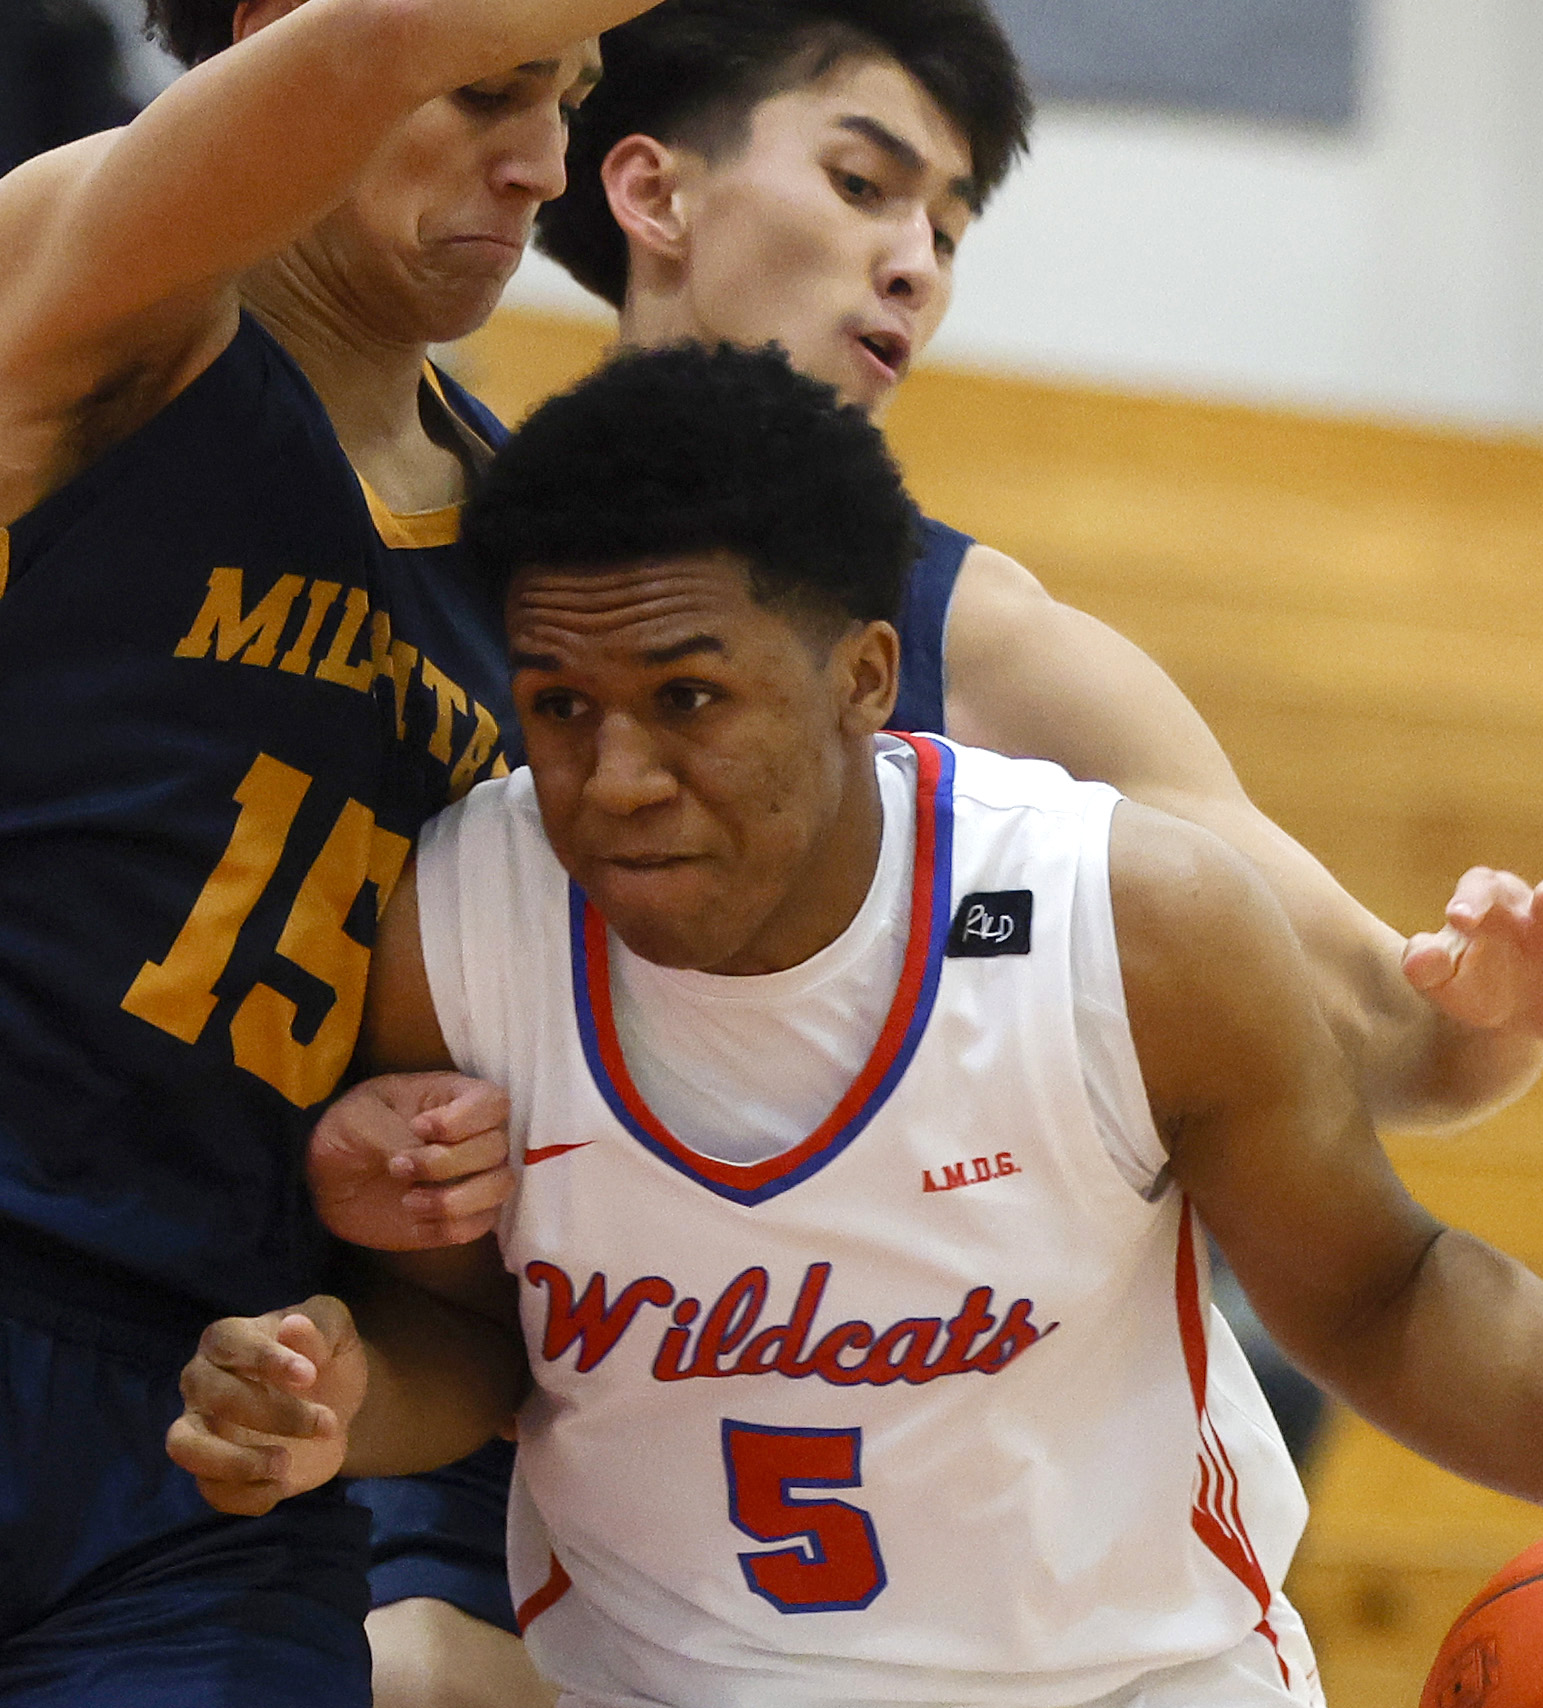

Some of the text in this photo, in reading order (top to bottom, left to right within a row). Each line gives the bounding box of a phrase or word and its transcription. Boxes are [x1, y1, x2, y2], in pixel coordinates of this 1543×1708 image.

[120, 751, 411, 1110] 15
[524, 1260, 1060, 1386] Wildcats
[721, 1417, 888, 1615] 5
